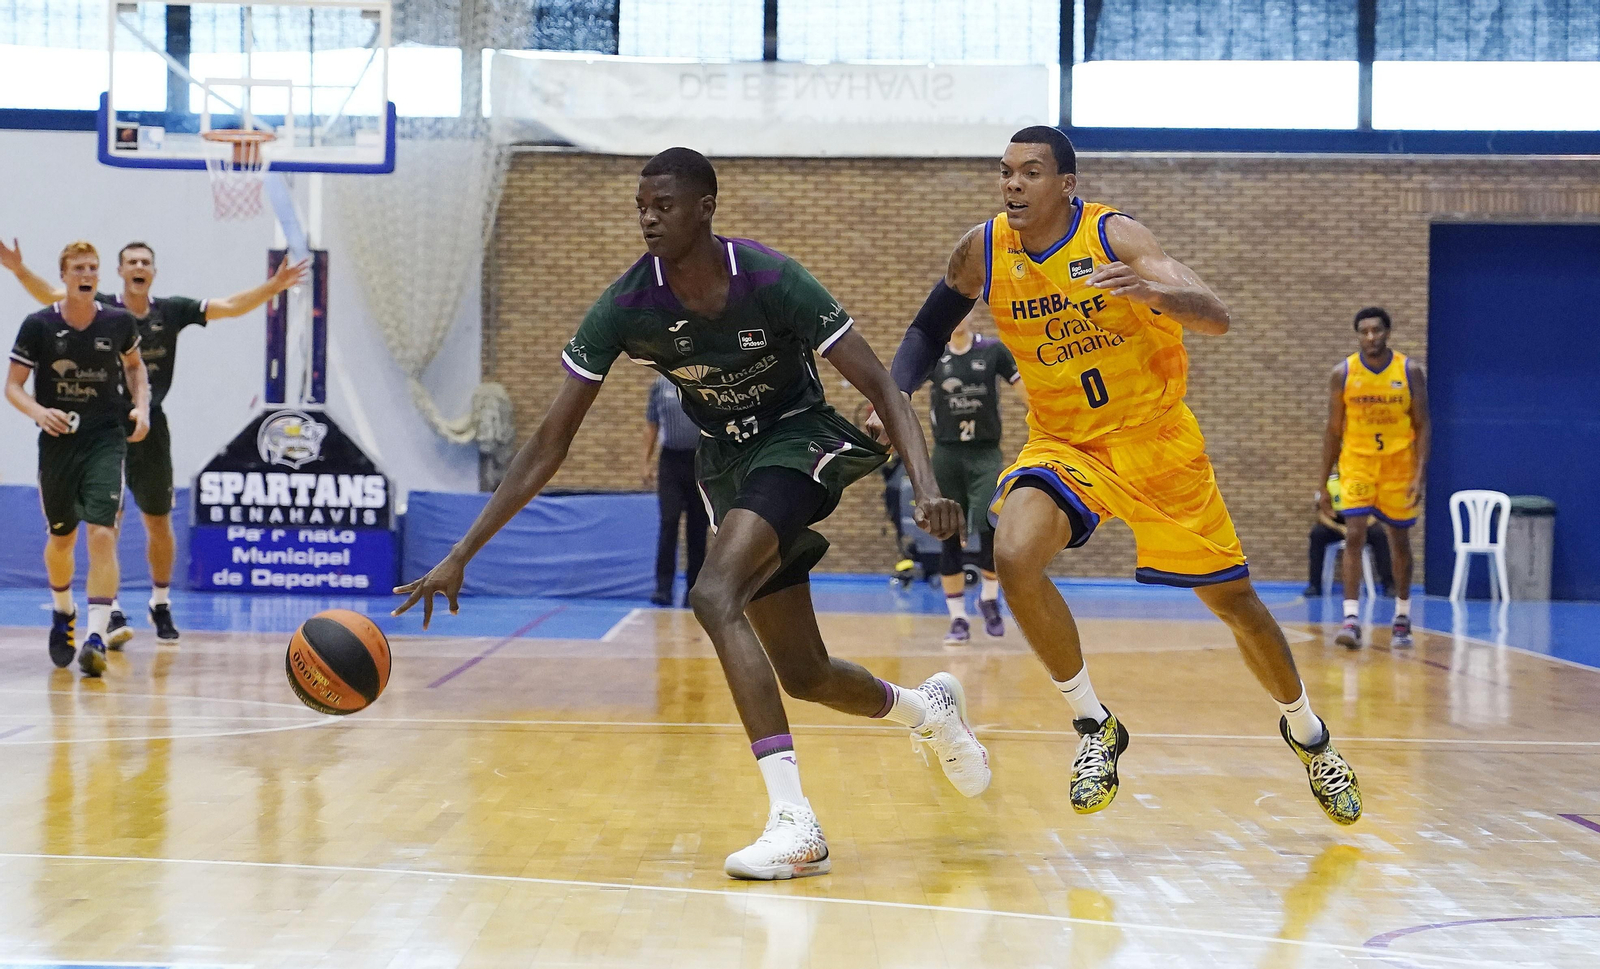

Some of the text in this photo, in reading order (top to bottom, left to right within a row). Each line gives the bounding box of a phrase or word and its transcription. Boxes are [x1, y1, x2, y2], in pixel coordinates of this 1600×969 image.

[1036, 332, 1126, 367] Canaria
[720, 354, 776, 384] Unicaja
[1080, 367, 1109, 409] 0
[1374, 433, 1385, 451] 5
[200, 471, 386, 508] SPARTANS
[232, 546, 350, 568] Municipal
[212, 568, 369, 590] de Deportes
